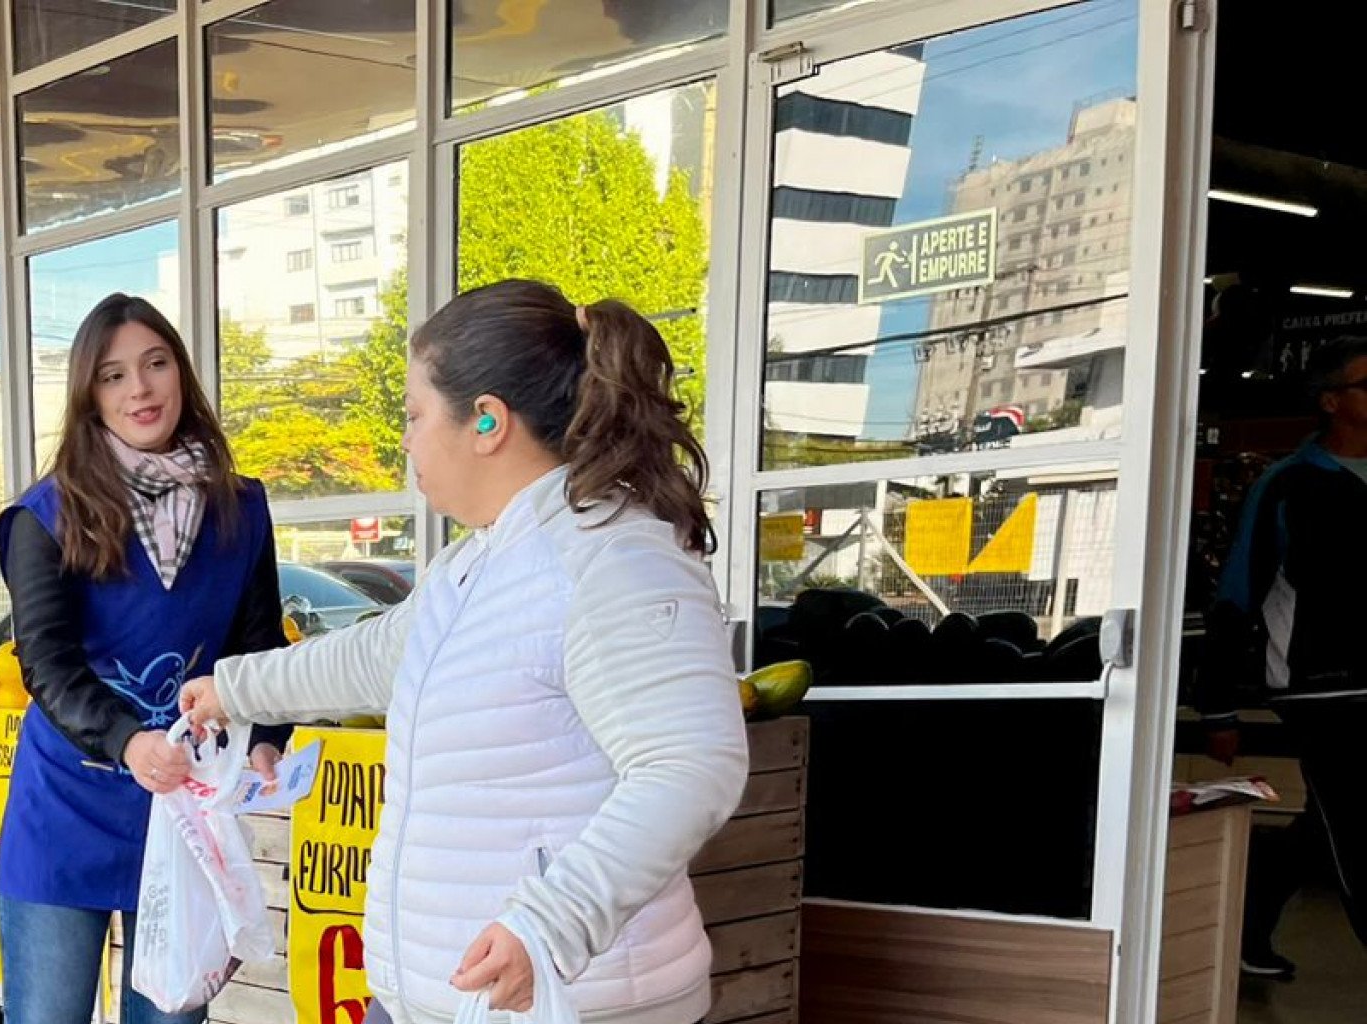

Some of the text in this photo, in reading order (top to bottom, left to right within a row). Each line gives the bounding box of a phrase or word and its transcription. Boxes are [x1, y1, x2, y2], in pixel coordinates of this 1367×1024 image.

[921, 221, 988, 256] APERTE E
[919, 249, 987, 283] EMPURRE
